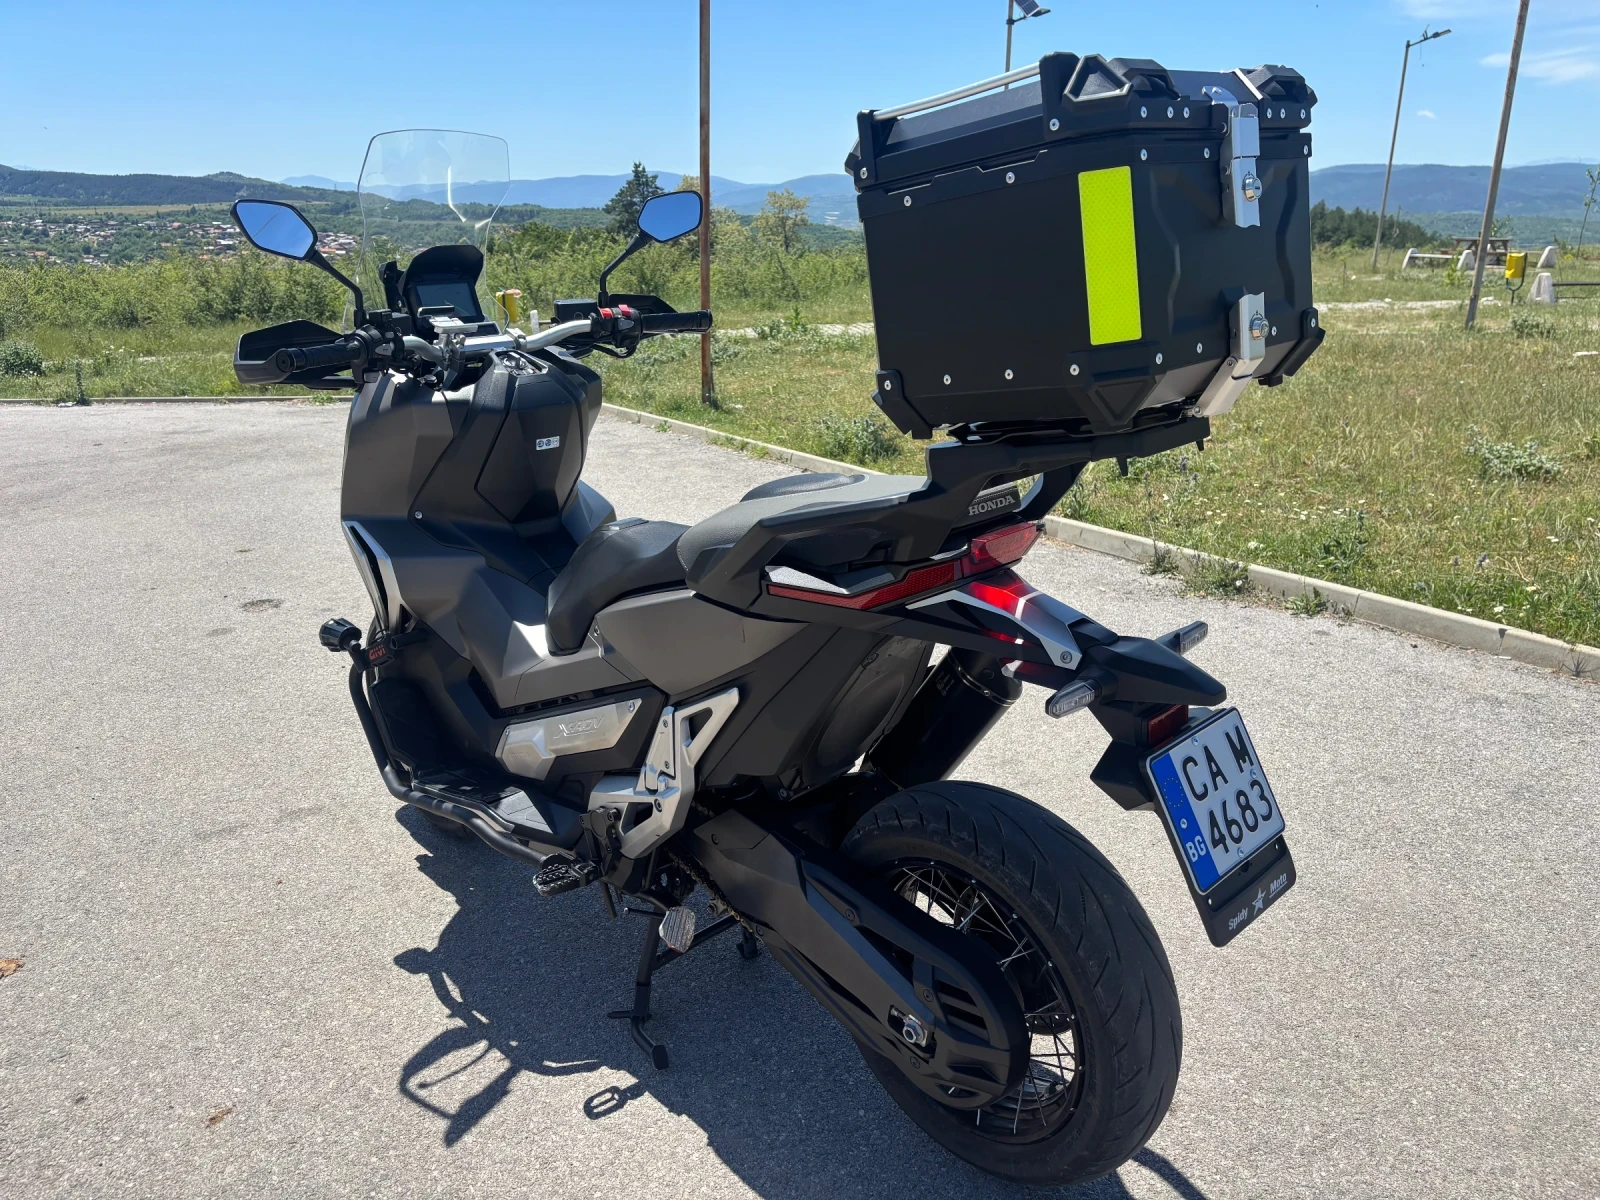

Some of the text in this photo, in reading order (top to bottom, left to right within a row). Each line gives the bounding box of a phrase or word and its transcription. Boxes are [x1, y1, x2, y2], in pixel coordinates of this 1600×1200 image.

[968, 495, 1016, 516] HONDA
[1182, 725, 1254, 801] CA M
[1209, 779, 1273, 854] 4683
[1186, 836, 1207, 862] BG
[1228, 873, 1287, 931] Spidy Moto
